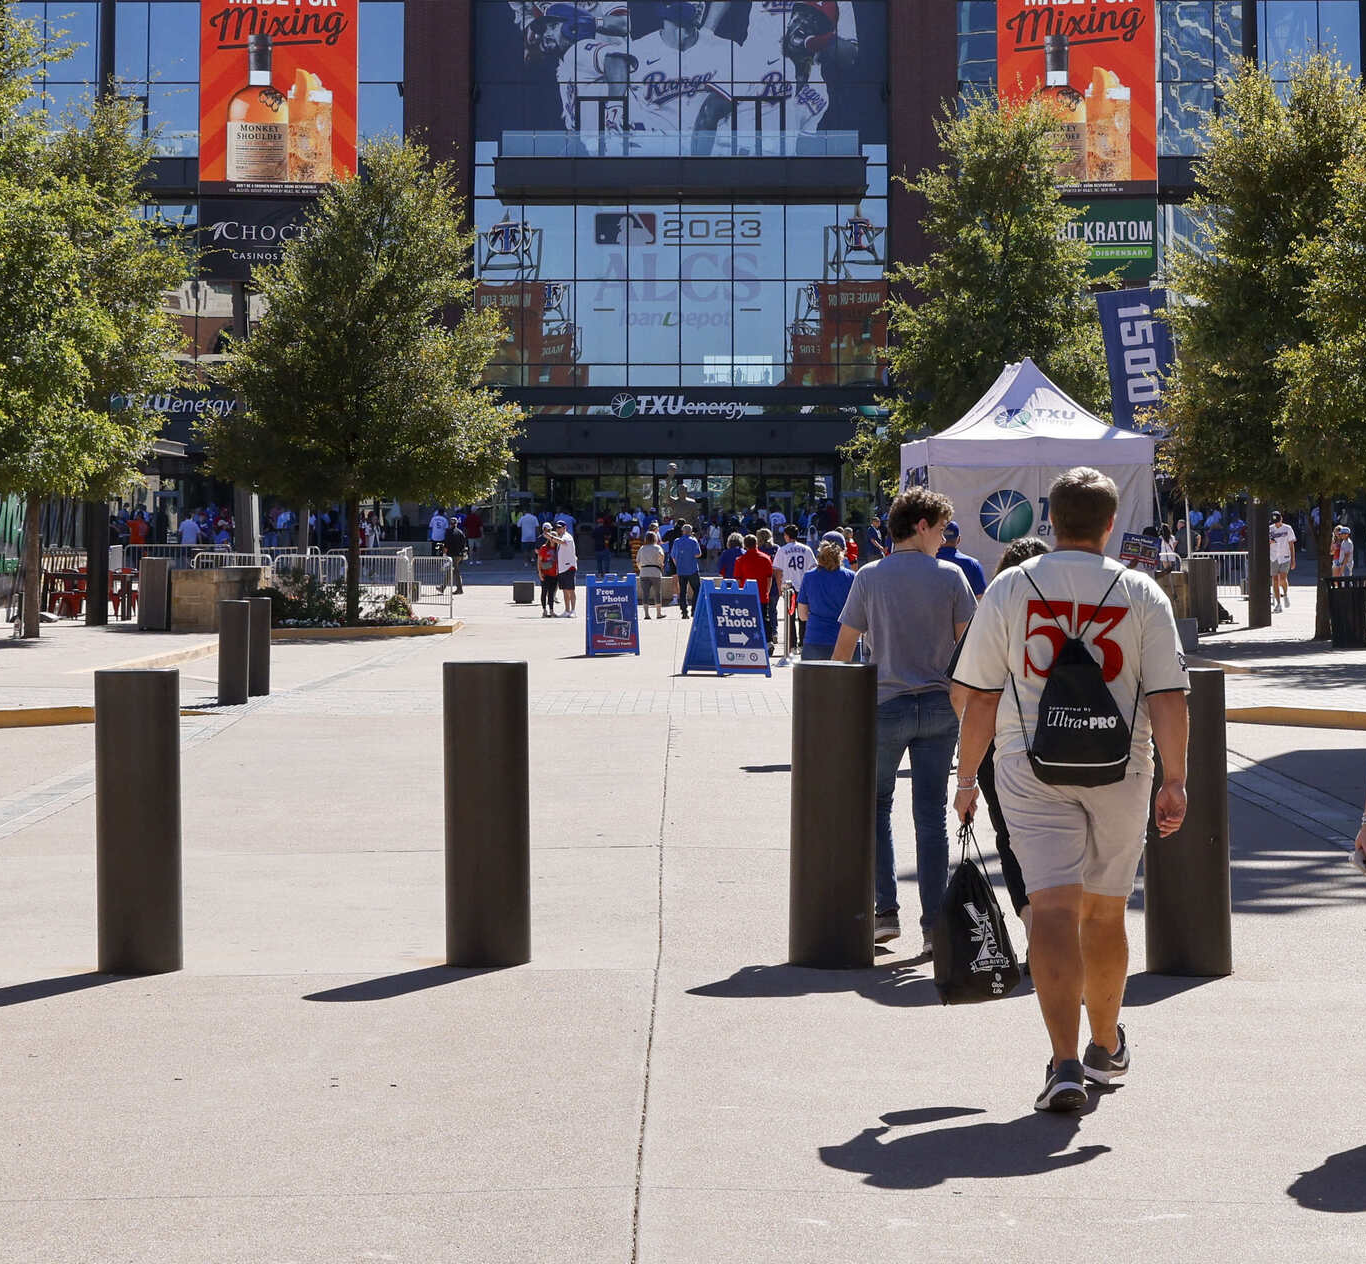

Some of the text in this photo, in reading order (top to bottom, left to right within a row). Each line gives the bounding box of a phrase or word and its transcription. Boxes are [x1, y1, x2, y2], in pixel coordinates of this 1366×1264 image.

[210, 6, 348, 45] Mixing
[1006, 6, 1146, 43] Mixing
[240, 124, 278, 133] MONKEY
[223, 222, 323, 241] CHOCT
[664, 219, 762, 239] 2023
[1084, 220, 1153, 241] KRATOM
[232, 252, 278, 260] CASINOS
[1096, 249, 1148, 257] DISPENSARY
[594, 252, 762, 303] ALCS
[1118, 302, 1161, 403] 1500
[1035, 409, 1076, 420] TXU
[788, 555, 805, 571] 48
[596, 588, 615, 596] Free
[602, 595, 629, 603] Photo!
[721, 605, 749, 617] Free
[717, 615, 757, 628] Photo!
[1024, 599, 1130, 683] 53
